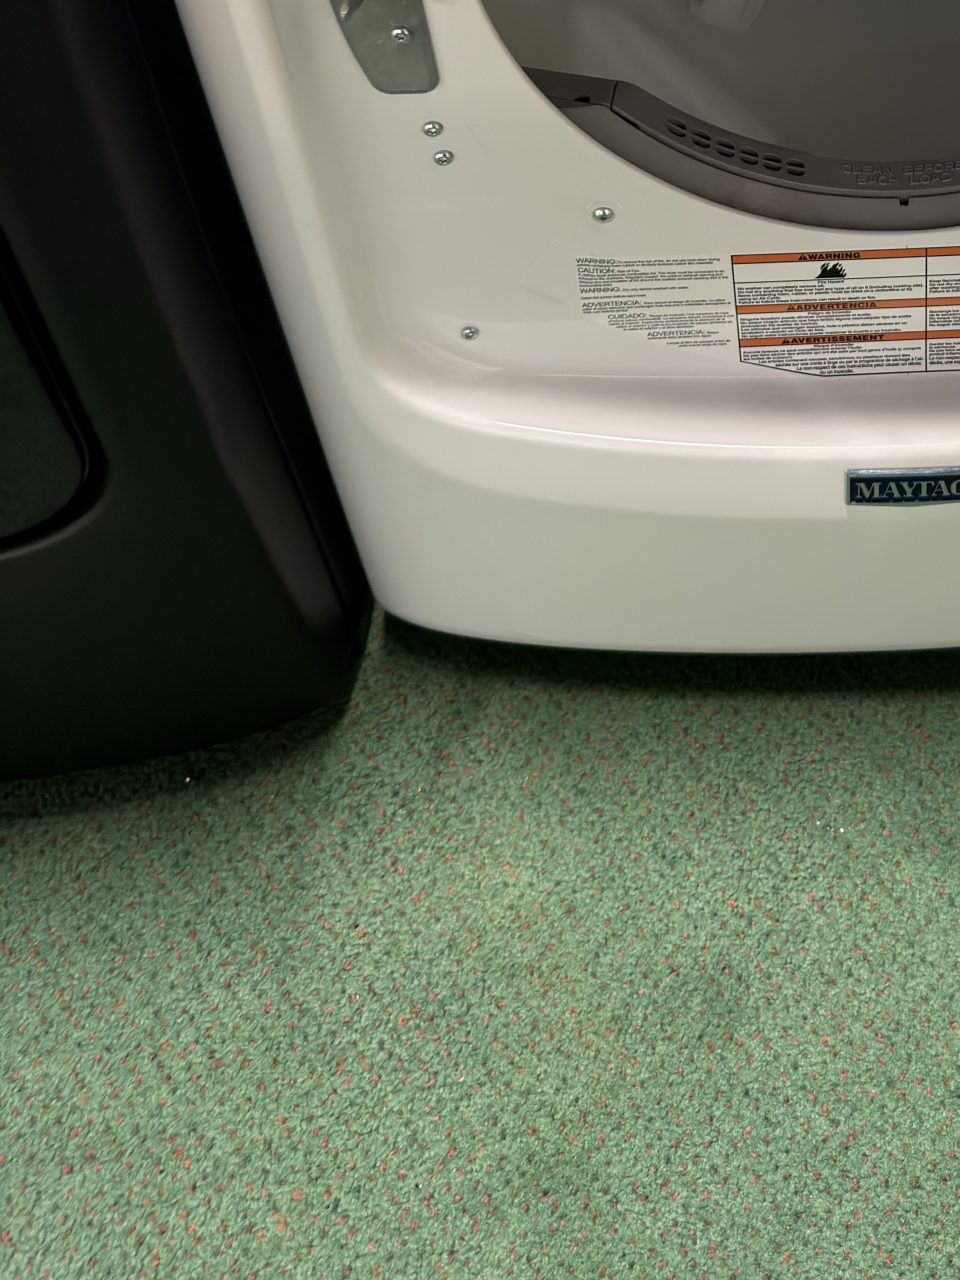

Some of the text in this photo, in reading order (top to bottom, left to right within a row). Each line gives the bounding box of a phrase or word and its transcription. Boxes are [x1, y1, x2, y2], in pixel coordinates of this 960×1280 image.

[841, 162, 894, 176] CLEAN
[856, 173, 952, 186] EACH LOAD
[808, 252, 861, 260] WARNING
[797, 302, 876, 311] ADVERTENCIA
[791, 334, 885, 344] AVERTISSEMENT
